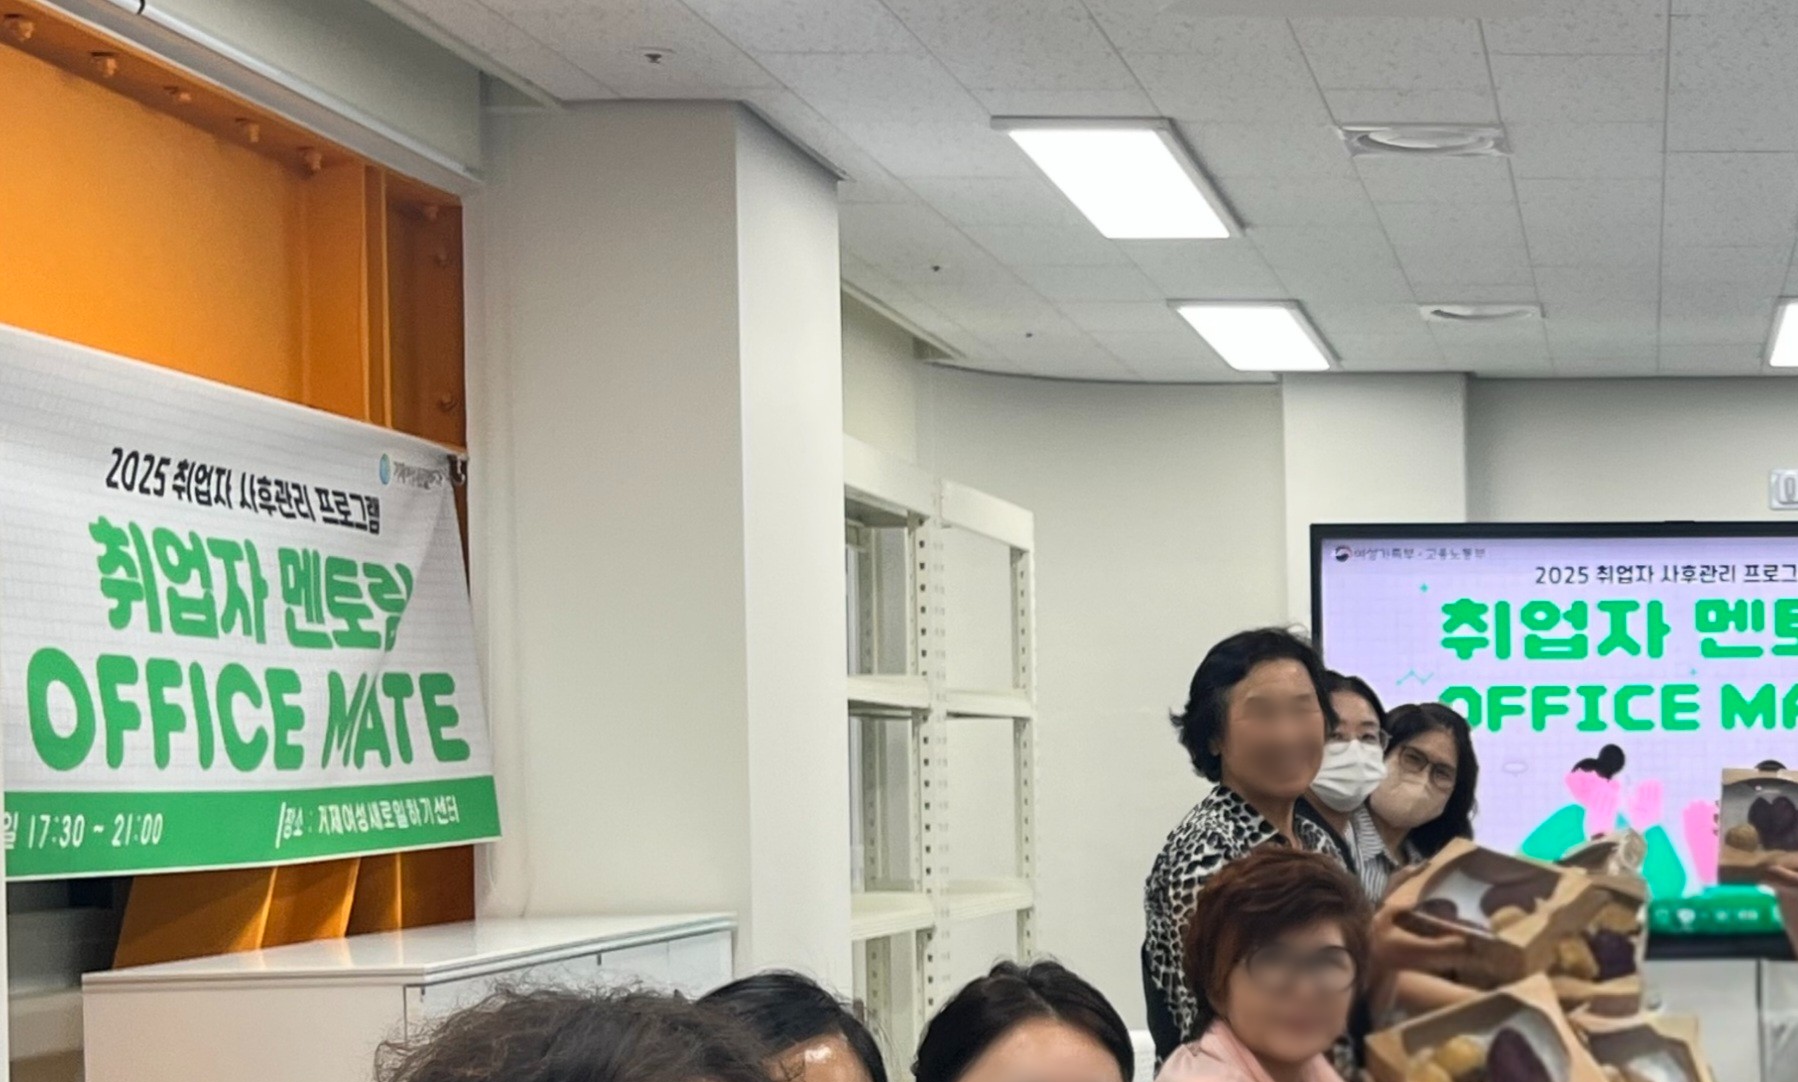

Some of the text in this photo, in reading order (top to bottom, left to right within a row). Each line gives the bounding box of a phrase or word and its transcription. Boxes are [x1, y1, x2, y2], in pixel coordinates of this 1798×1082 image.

[107, 448, 380, 534] 2025 취업자 사후관리 프로그램
[89, 516, 268, 644] 취업자
[1535, 566, 1589, 584] 2025
[1597, 564, 1654, 584] 취업자
[1661, 564, 1736, 584] 사후관리
[1440, 597, 1672, 661] 취업자
[27, 647, 471, 772] OFFICE MATE
[1439, 683, 1701, 733] OFFICE
[28, 814, 85, 849] 17:30
[111, 812, 163, 847] 21:00
